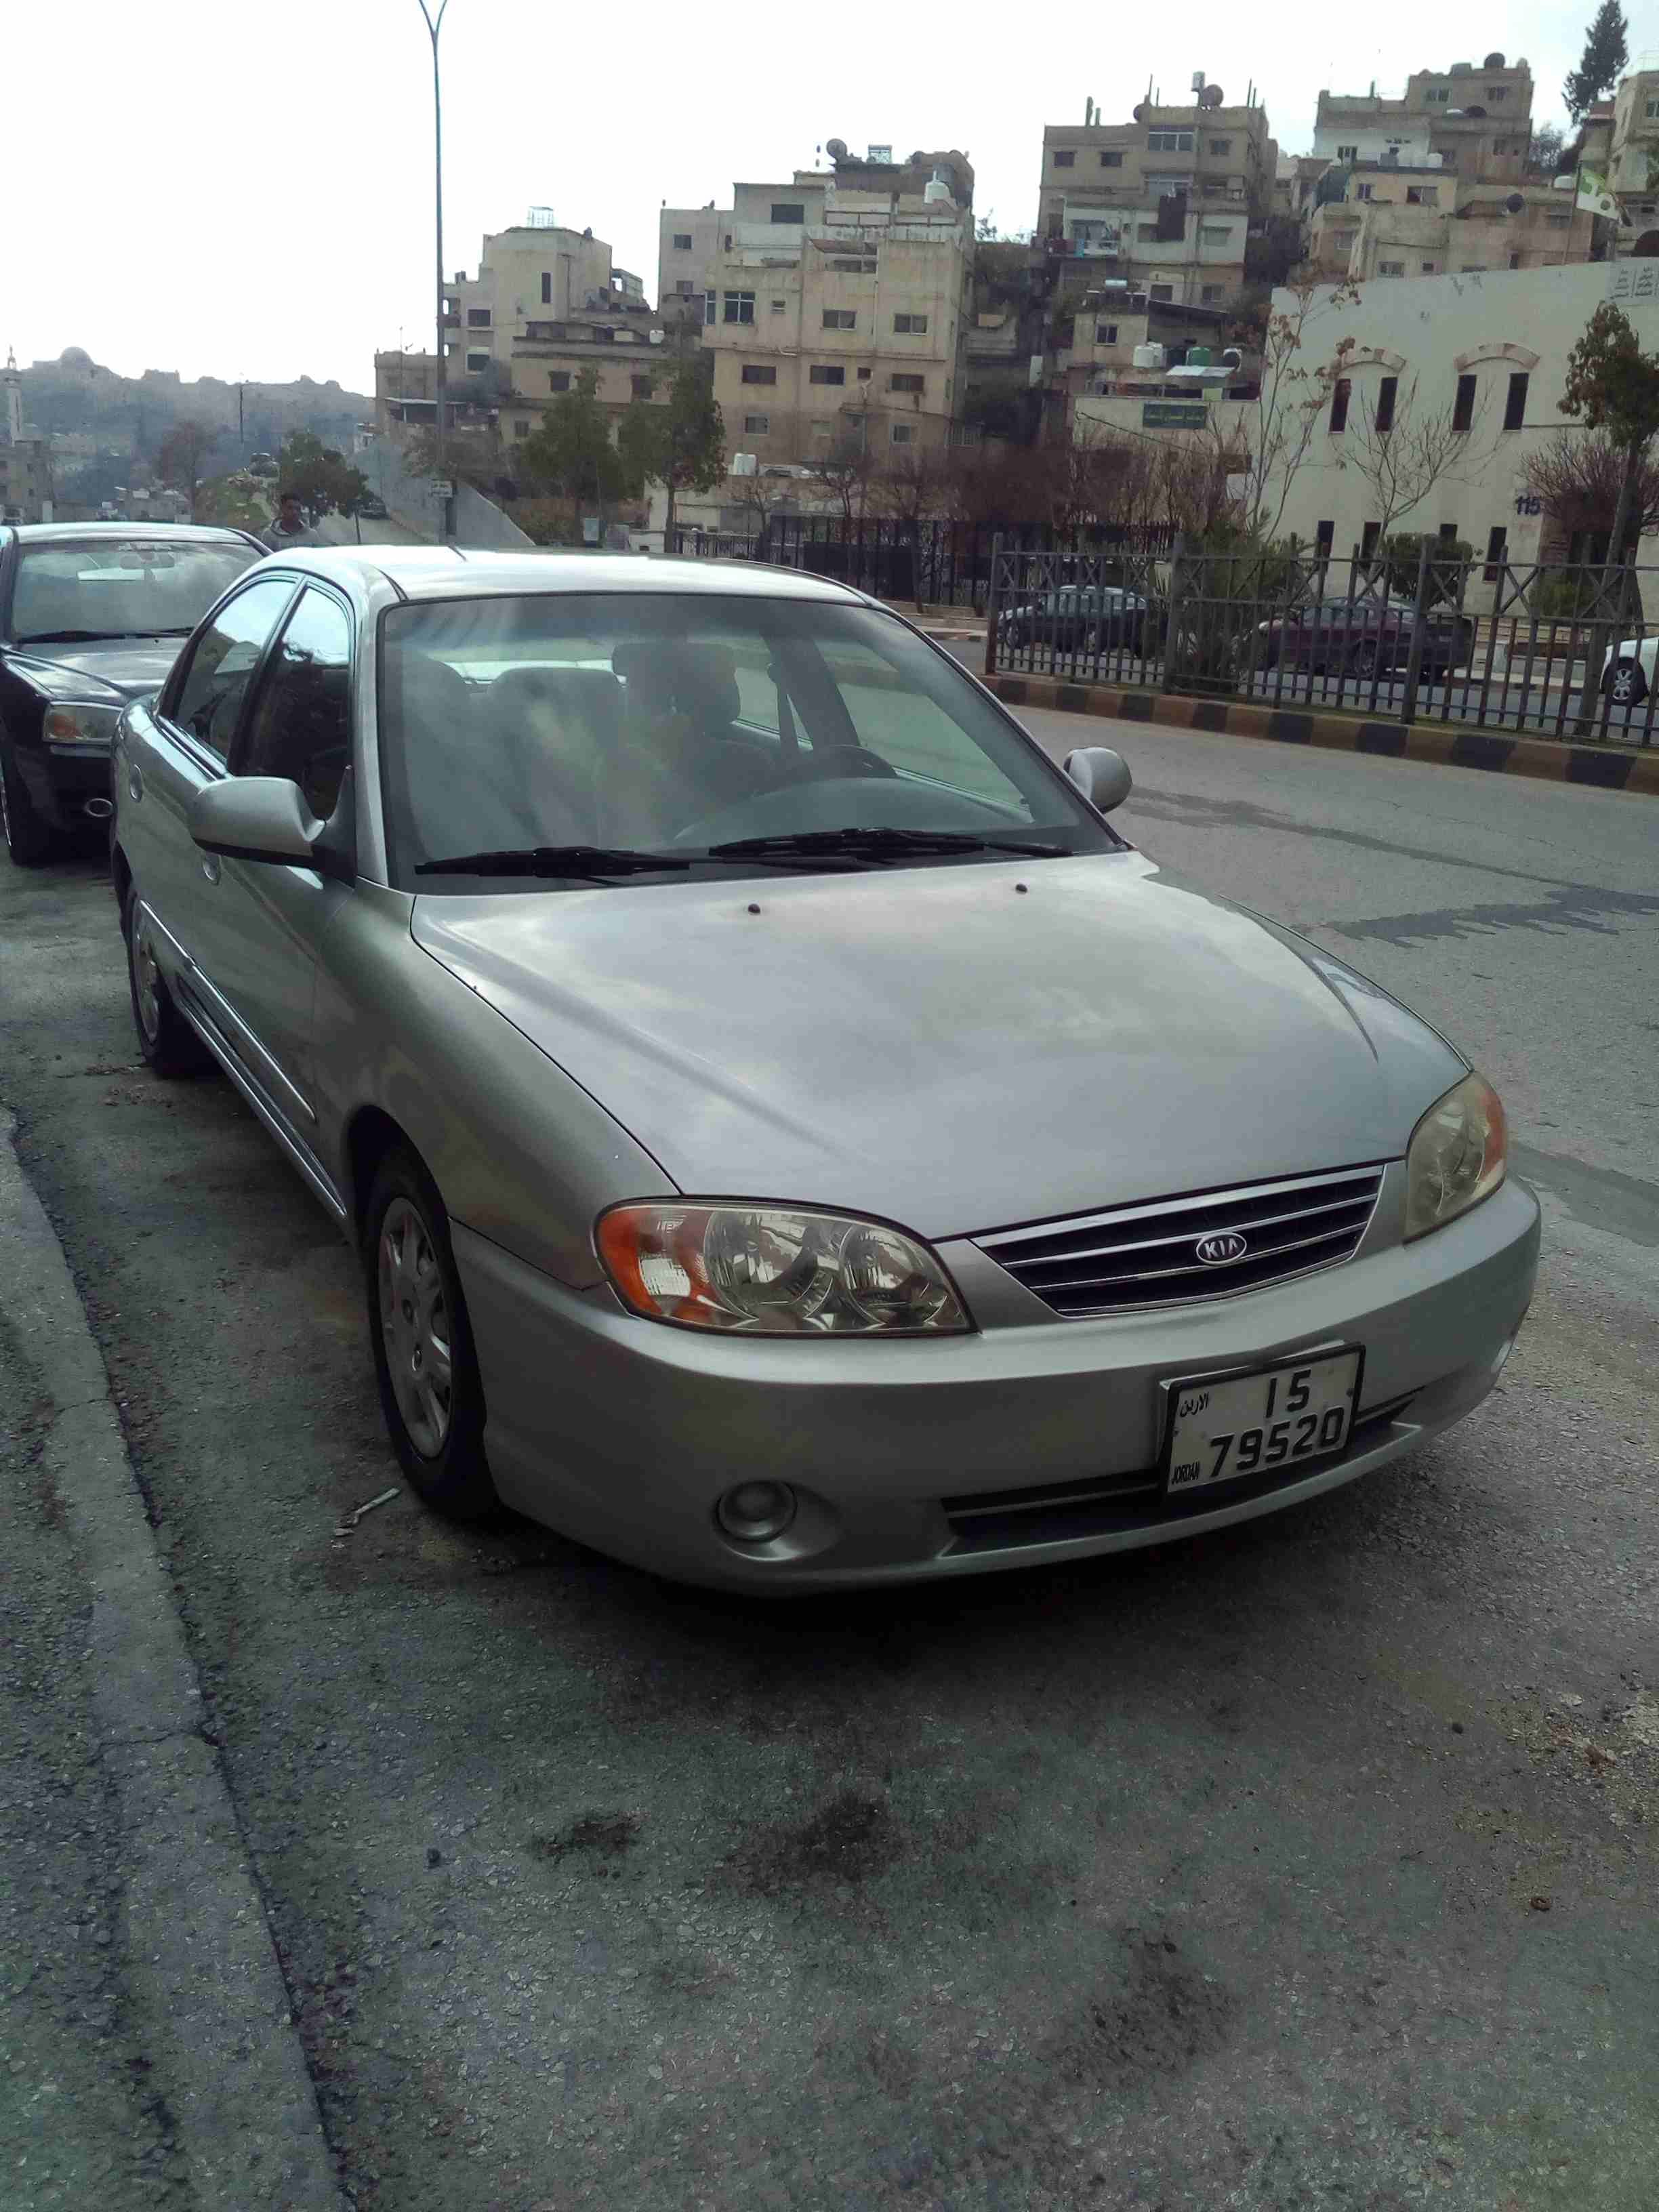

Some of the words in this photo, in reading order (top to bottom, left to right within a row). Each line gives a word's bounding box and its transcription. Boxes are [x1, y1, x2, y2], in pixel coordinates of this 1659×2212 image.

[1515, 495, 1540, 516] 115
[1204, 1238, 1238, 1258] KIA
[1265, 1369, 1311, 1418] 15
[1210, 1407, 1345, 1477] 79520
[1172, 1461, 1200, 1484] JORDAN
